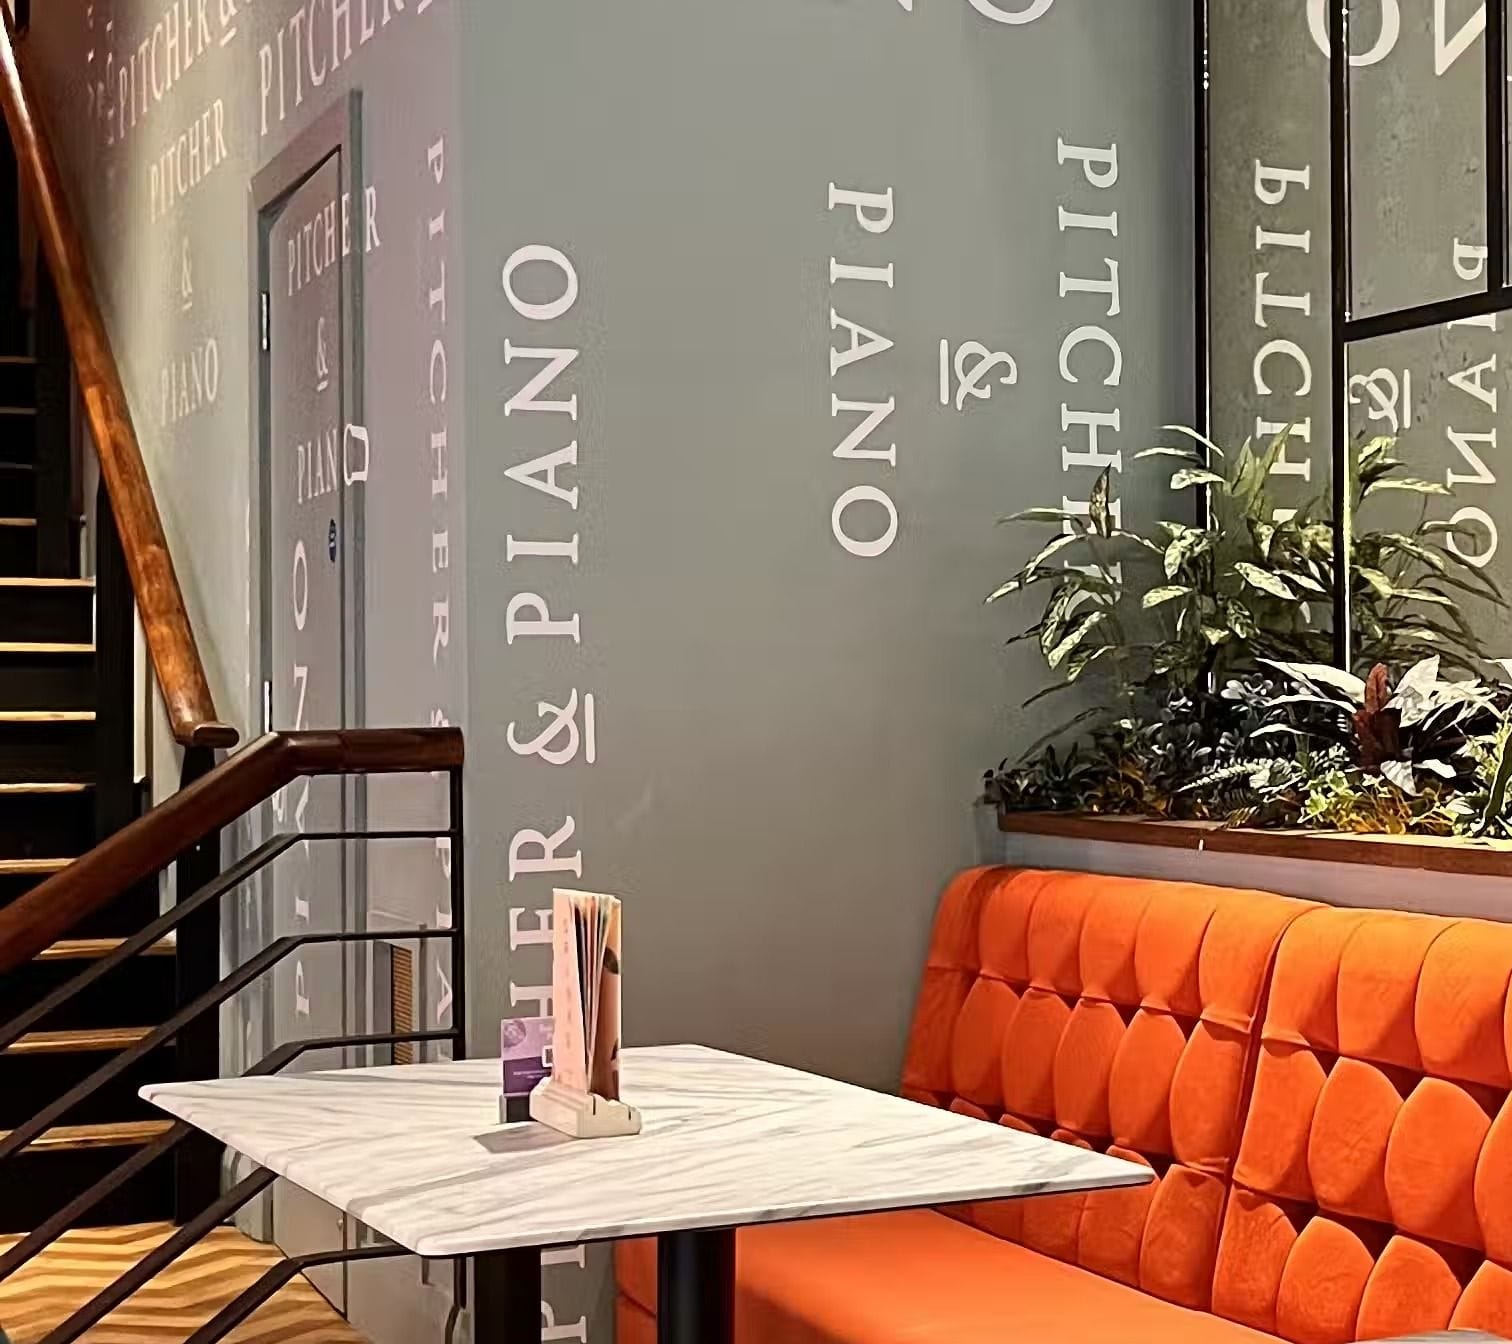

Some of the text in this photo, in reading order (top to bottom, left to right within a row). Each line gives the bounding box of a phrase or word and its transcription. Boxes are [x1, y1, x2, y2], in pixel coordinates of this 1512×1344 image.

[151, 98, 227, 224] PITCHER
[287, 186, 381, 296] PITCHER
[160, 338, 219, 428] PIANO
[427, 136, 450, 664] PITCHER
[828, 183, 898, 558] PIANO
[938, 338, 1018, 410] &
[502, 244, 581, 646] PIANO
[506, 687, 596, 764] &
